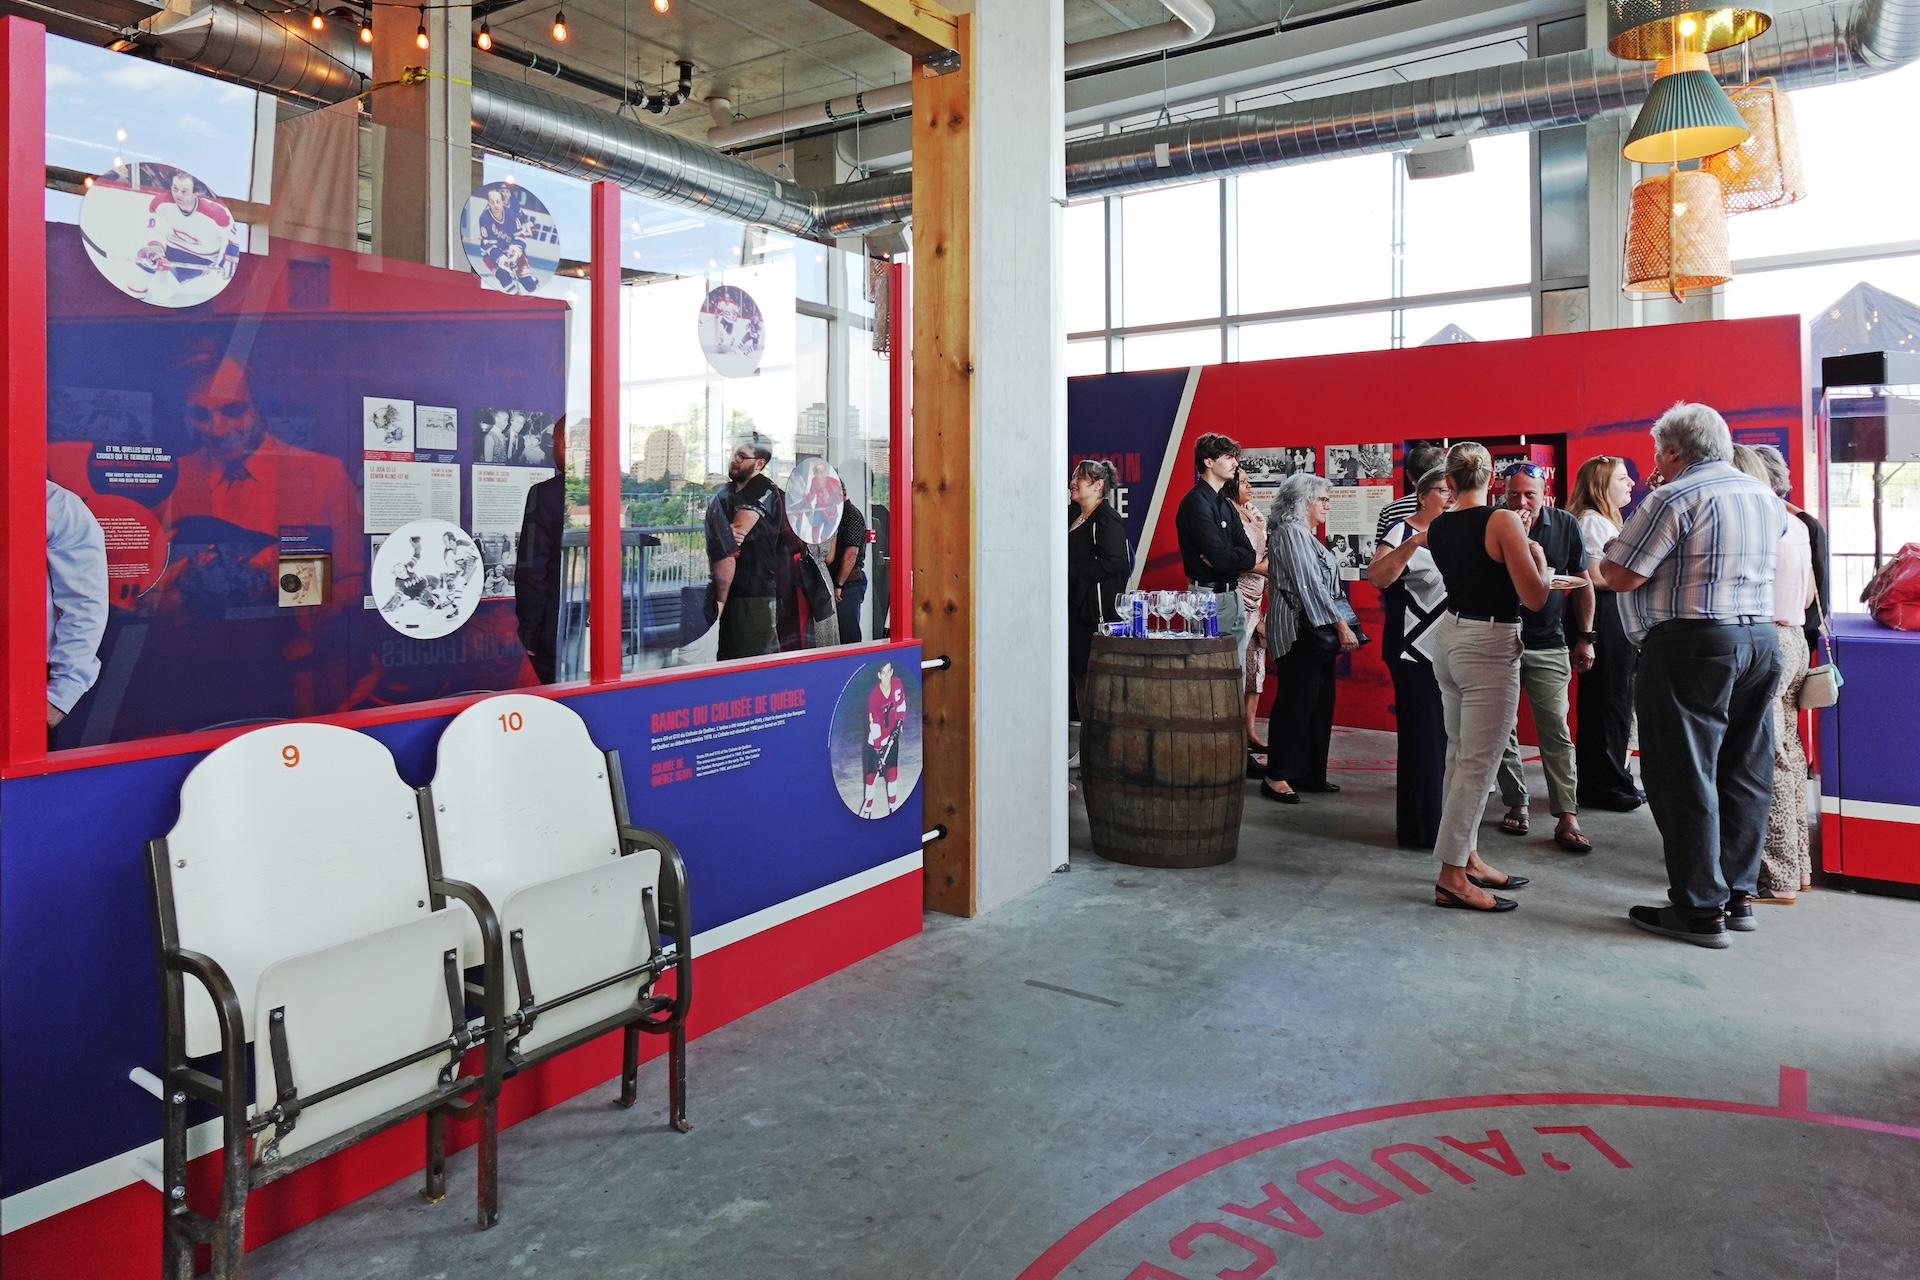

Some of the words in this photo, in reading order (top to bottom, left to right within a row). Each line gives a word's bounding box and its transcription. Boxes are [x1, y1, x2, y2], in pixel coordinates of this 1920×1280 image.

[498, 712, 522, 732] 10
[651, 708, 690, 734] BANCS
[693, 706, 708, 726] DU
[711, 696, 752, 722] COLISÉE
[755, 695, 767, 714] DE
[770, 688, 806, 713] QUÉBEC
[281, 744, 299, 768] 9
